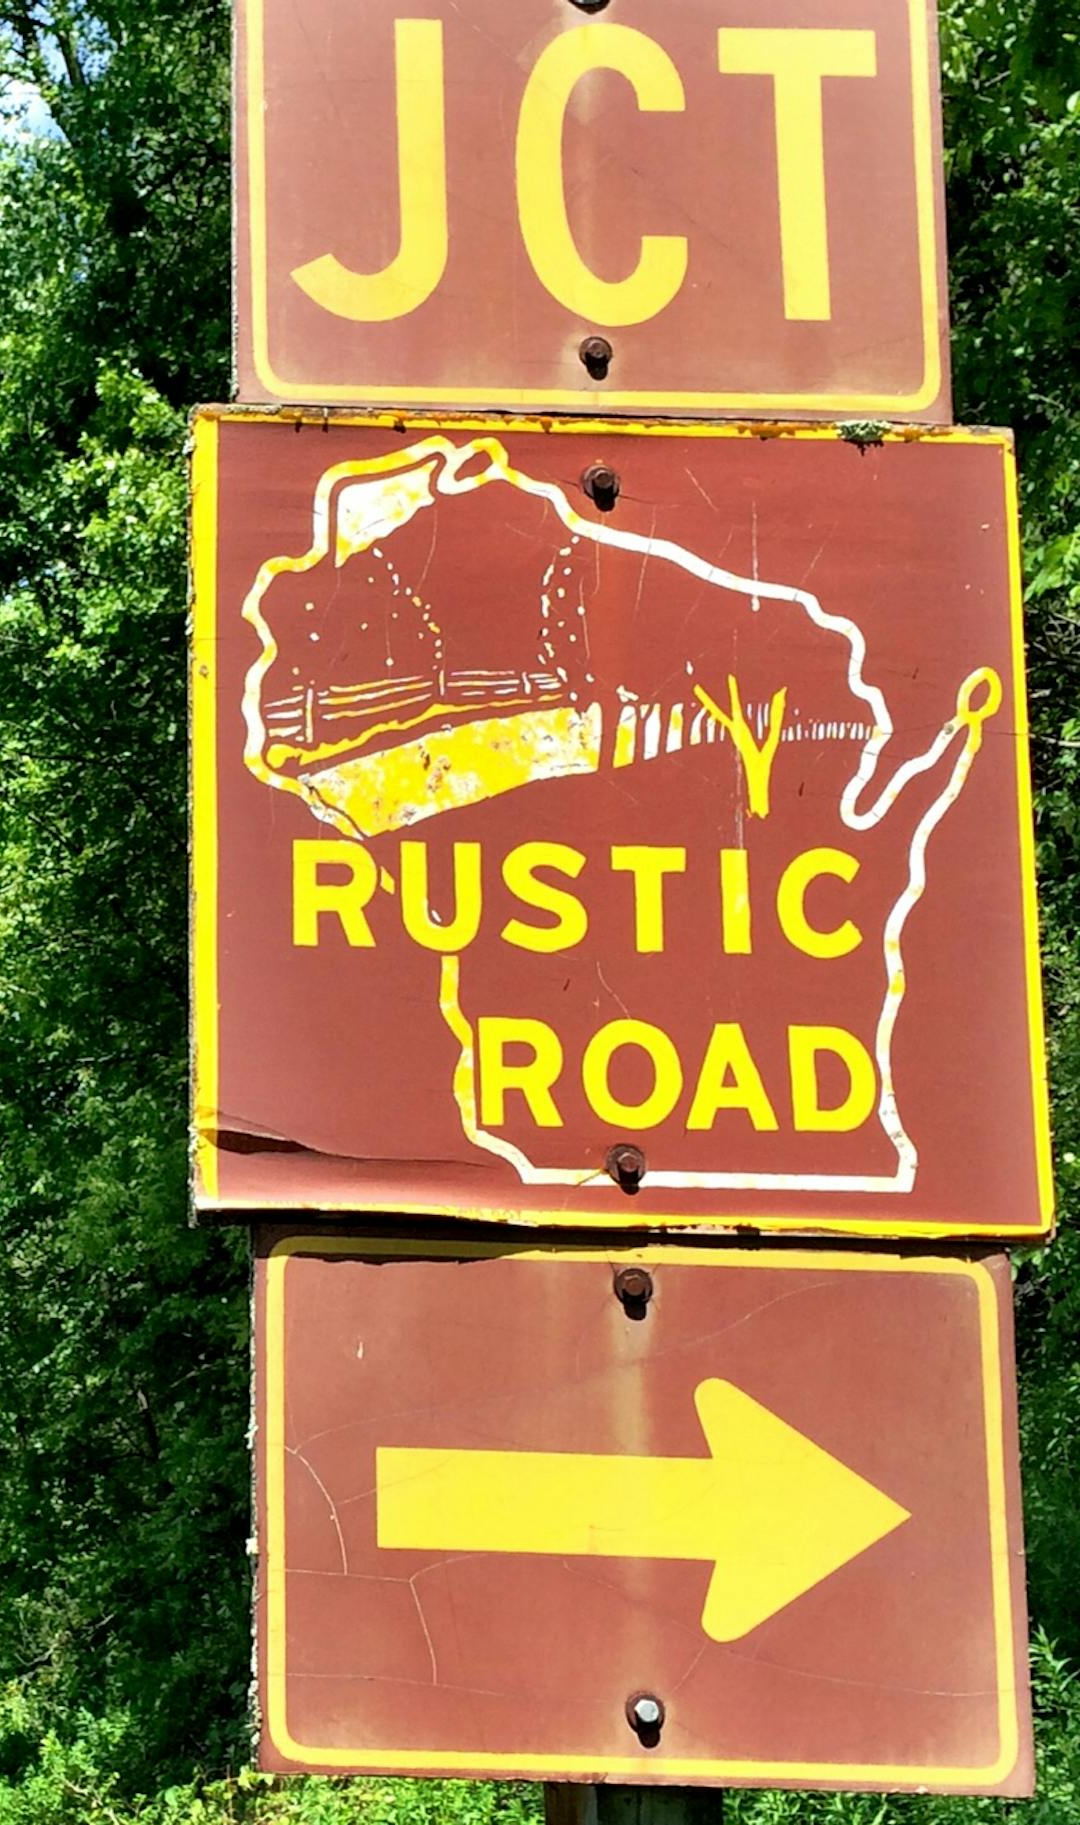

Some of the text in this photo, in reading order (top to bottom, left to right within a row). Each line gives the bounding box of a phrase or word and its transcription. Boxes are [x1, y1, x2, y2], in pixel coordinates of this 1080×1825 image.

[290, 18, 877, 326] JCT
[292, 839, 863, 959] RUSTIC
[477, 1017, 877, 1133] ROAD
